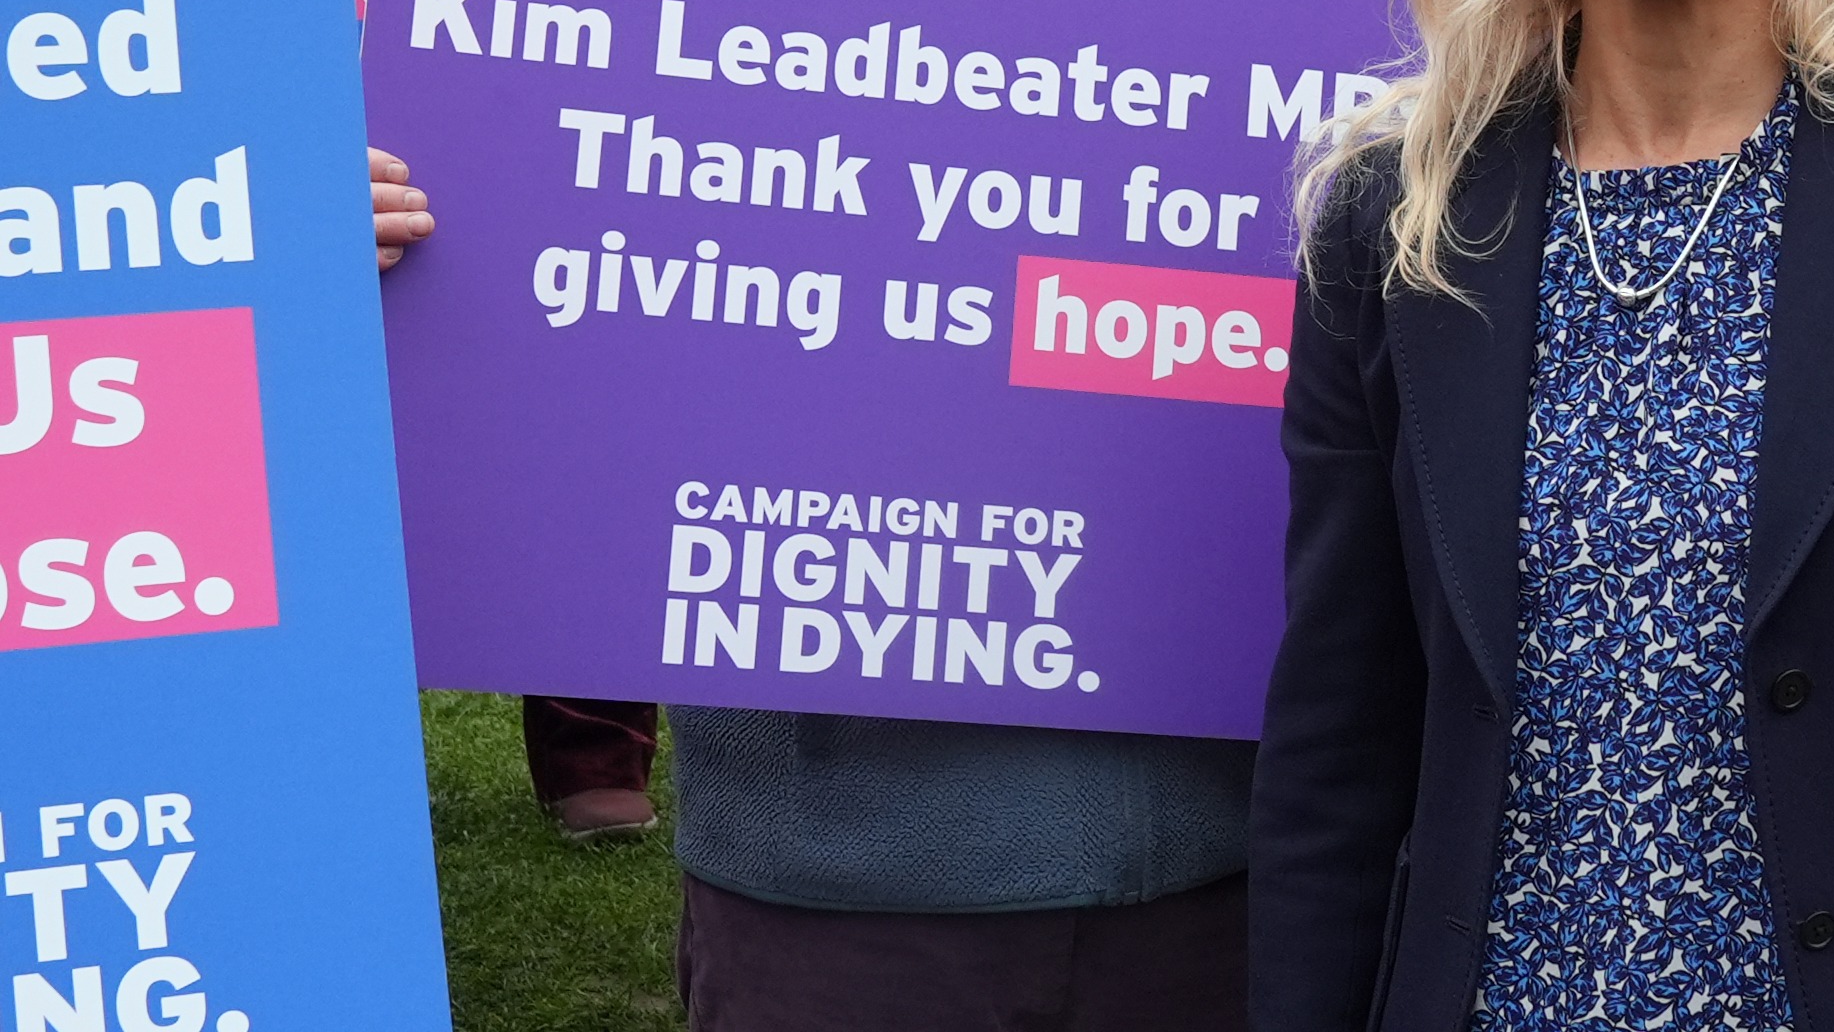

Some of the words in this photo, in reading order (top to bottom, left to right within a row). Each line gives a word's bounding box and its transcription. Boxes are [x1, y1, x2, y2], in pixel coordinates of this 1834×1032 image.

[0, 144, 255, 278] and
[558, 109, 872, 217] Thank
[908, 162, 1083, 242] you
[1123, 165, 1261, 252] for
[532, 230, 842, 351] giving
[882, 279, 994, 346] us
[1033, 274, 1290, 380] hope.
[675, 480, 959, 539] CAMPAIGN
[981, 504, 1086, 548] FOR
[0, 530, 235, 630] se.
[667, 524, 1084, 619] DIGNITY
[661, 598, 760, 670] IN
[779, 605, 1101, 693] DYING.
[39, 792, 195, 859] FOR
[4, 851, 197, 963] TY
